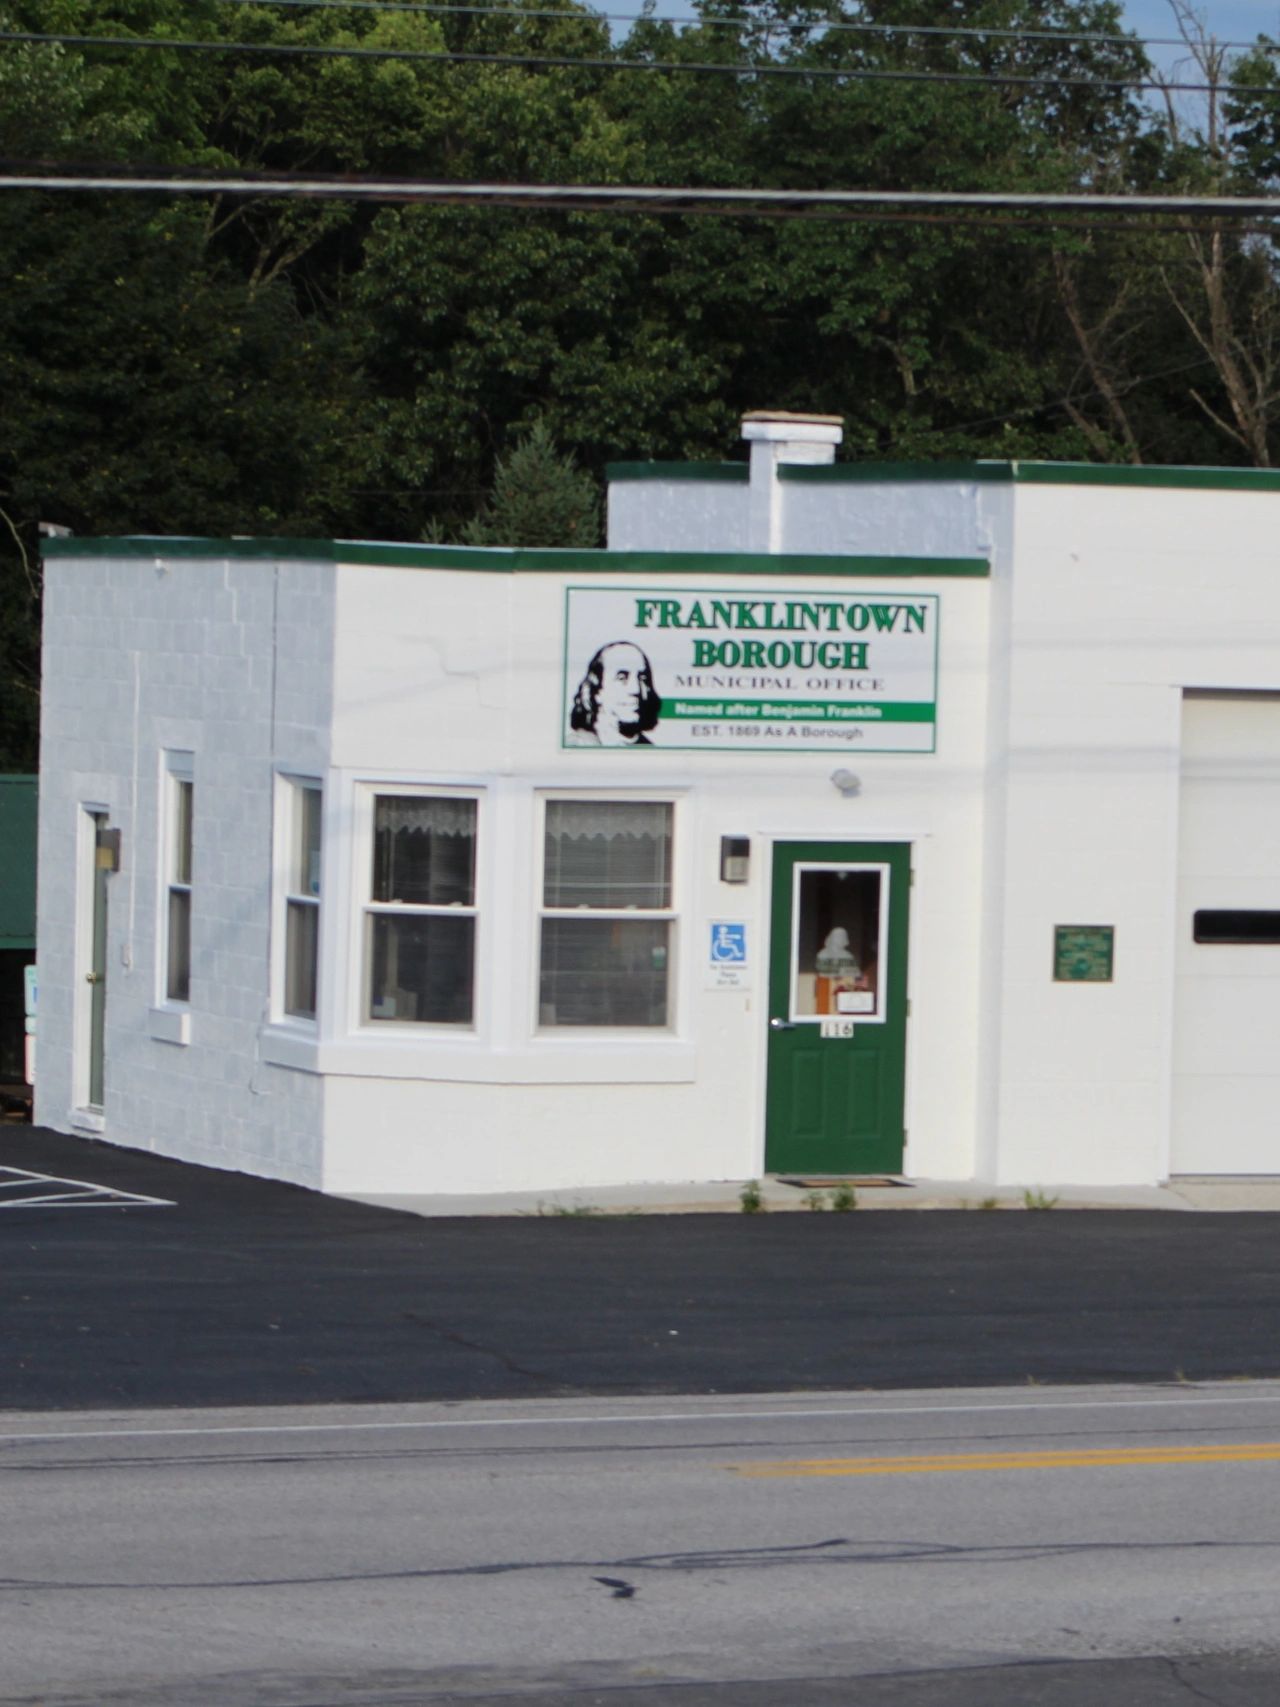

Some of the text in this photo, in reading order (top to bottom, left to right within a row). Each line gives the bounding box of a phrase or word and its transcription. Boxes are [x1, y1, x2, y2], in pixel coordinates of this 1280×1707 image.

[635, 599, 927, 633] FRANKLINTOWN
[692, 639, 869, 670] BOROUGH
[674, 675, 885, 691] MUNICIPAL OFFICE
[675, 702, 882, 719] Named after Benjamin Franklin
[692, 725, 722, 736] EST.
[764, 727, 783, 738] As
[787, 728, 798, 738] A
[801, 728, 864, 740] Borough
